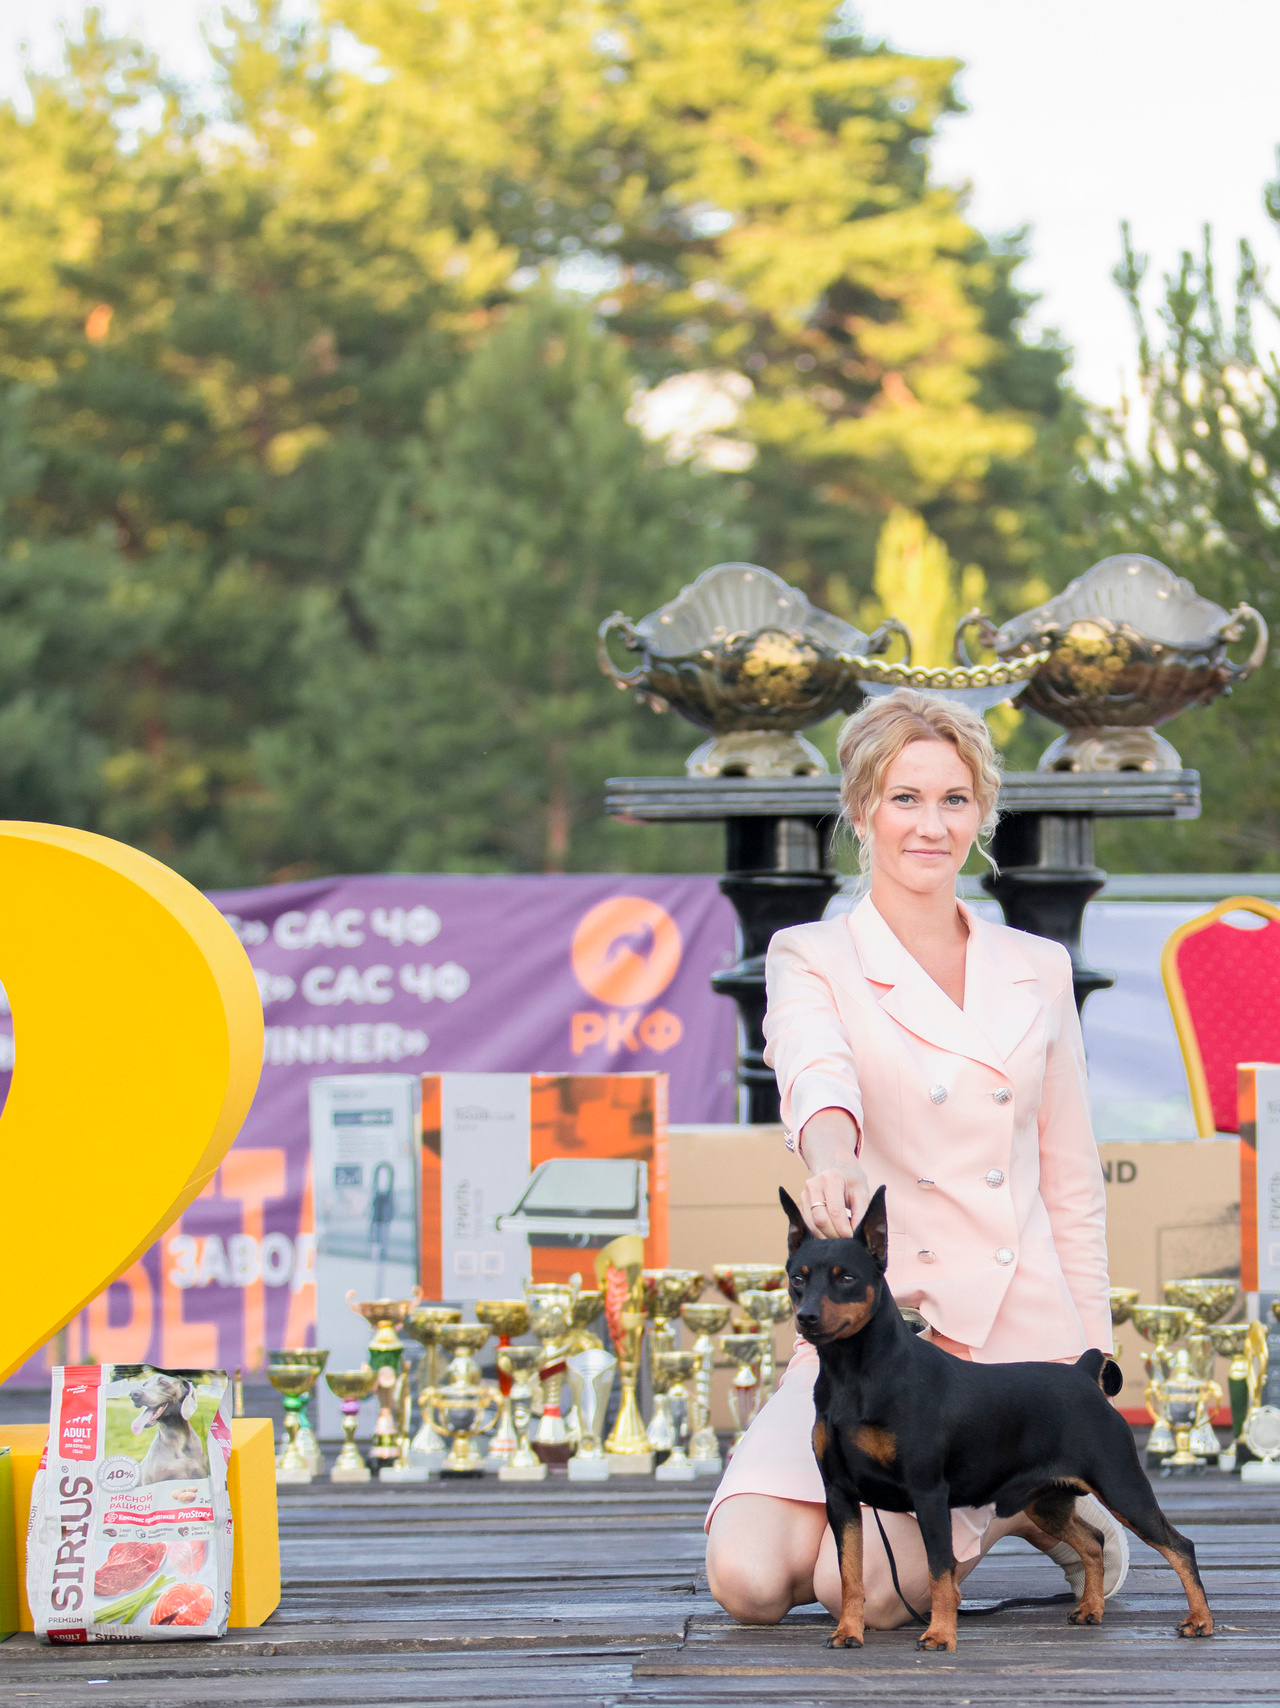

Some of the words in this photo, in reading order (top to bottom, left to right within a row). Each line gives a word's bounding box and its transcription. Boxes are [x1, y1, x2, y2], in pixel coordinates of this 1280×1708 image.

[571, 1008, 683, 1057] РКФ
[64, 1428, 92, 1438] ADULT
[106, 1470, 134, 1480] 40%
[110, 1492, 153, 1502] МЯСНОЙ
[110, 1503, 151, 1511] РАЦИОН
[178, 1510, 211, 1519] ProStor+
[51, 1476, 93, 1611] SIRIUS
